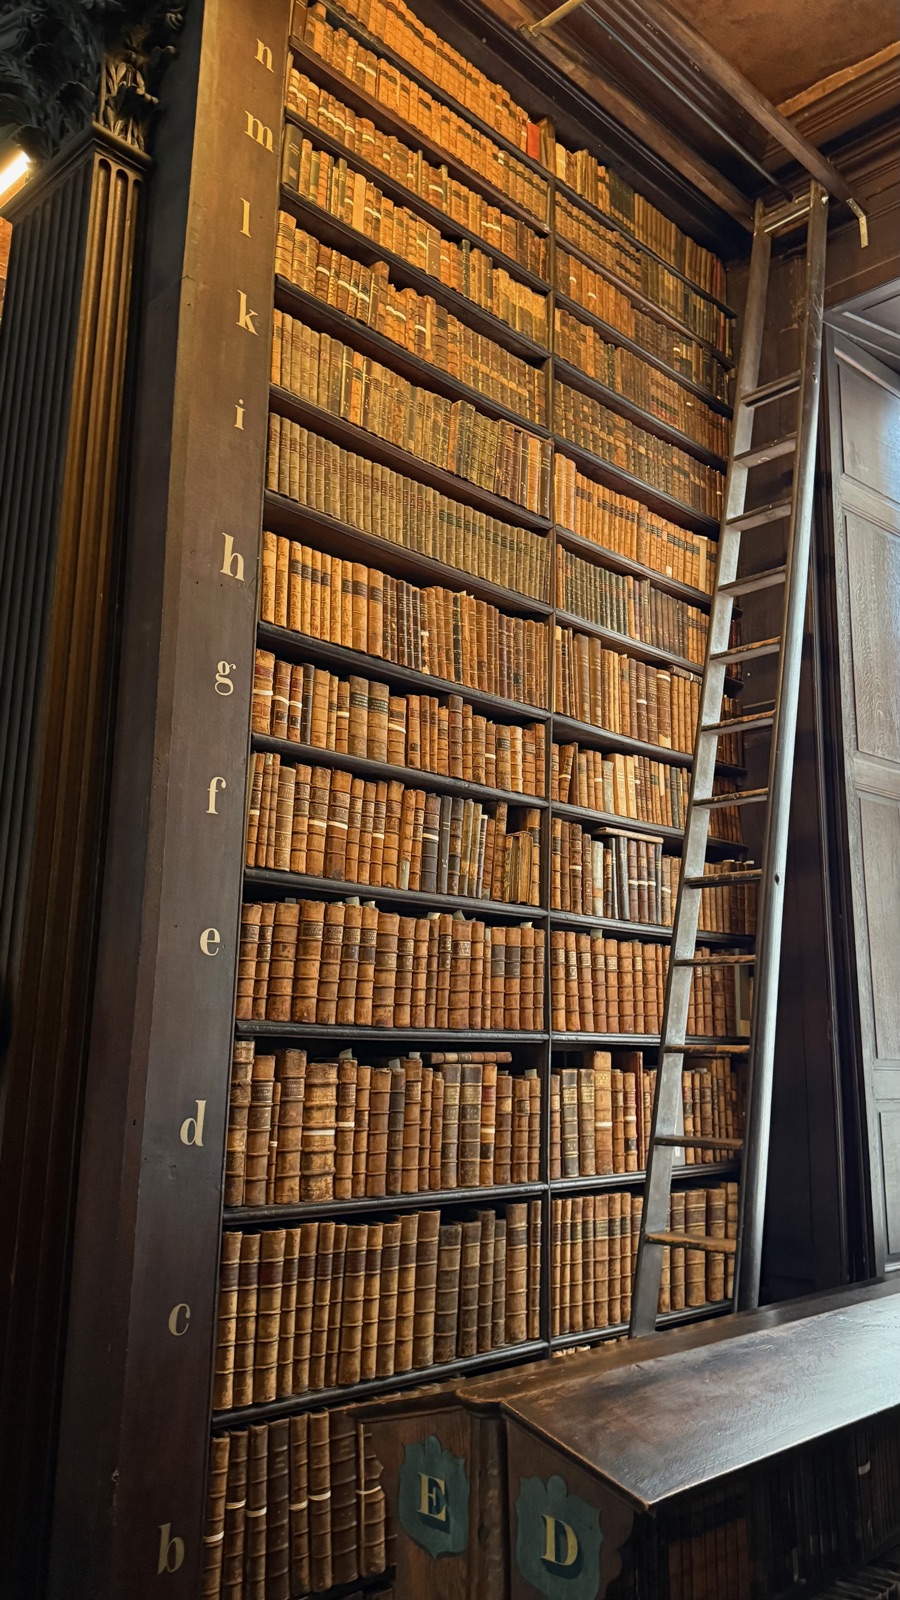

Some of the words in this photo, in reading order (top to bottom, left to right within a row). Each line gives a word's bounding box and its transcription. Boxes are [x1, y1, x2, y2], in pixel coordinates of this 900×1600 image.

[255, 39, 275, 73] n
[245, 110, 274, 152] m
[239, 198, 252, 238] l
[236, 290, 259, 336] k
[234, 399, 245, 430] i
[220, 532, 245, 582] h
[214, 660, 237, 696] g
[206, 776, 227, 815] f
[200, 927, 220, 956] e
[180, 1100, 207, 1147] d
[168, 1303, 191, 1336] c
[417, 1472, 447, 1522] E
[157, 1522, 185, 1575] b
[540, 1514, 579, 1566] D
